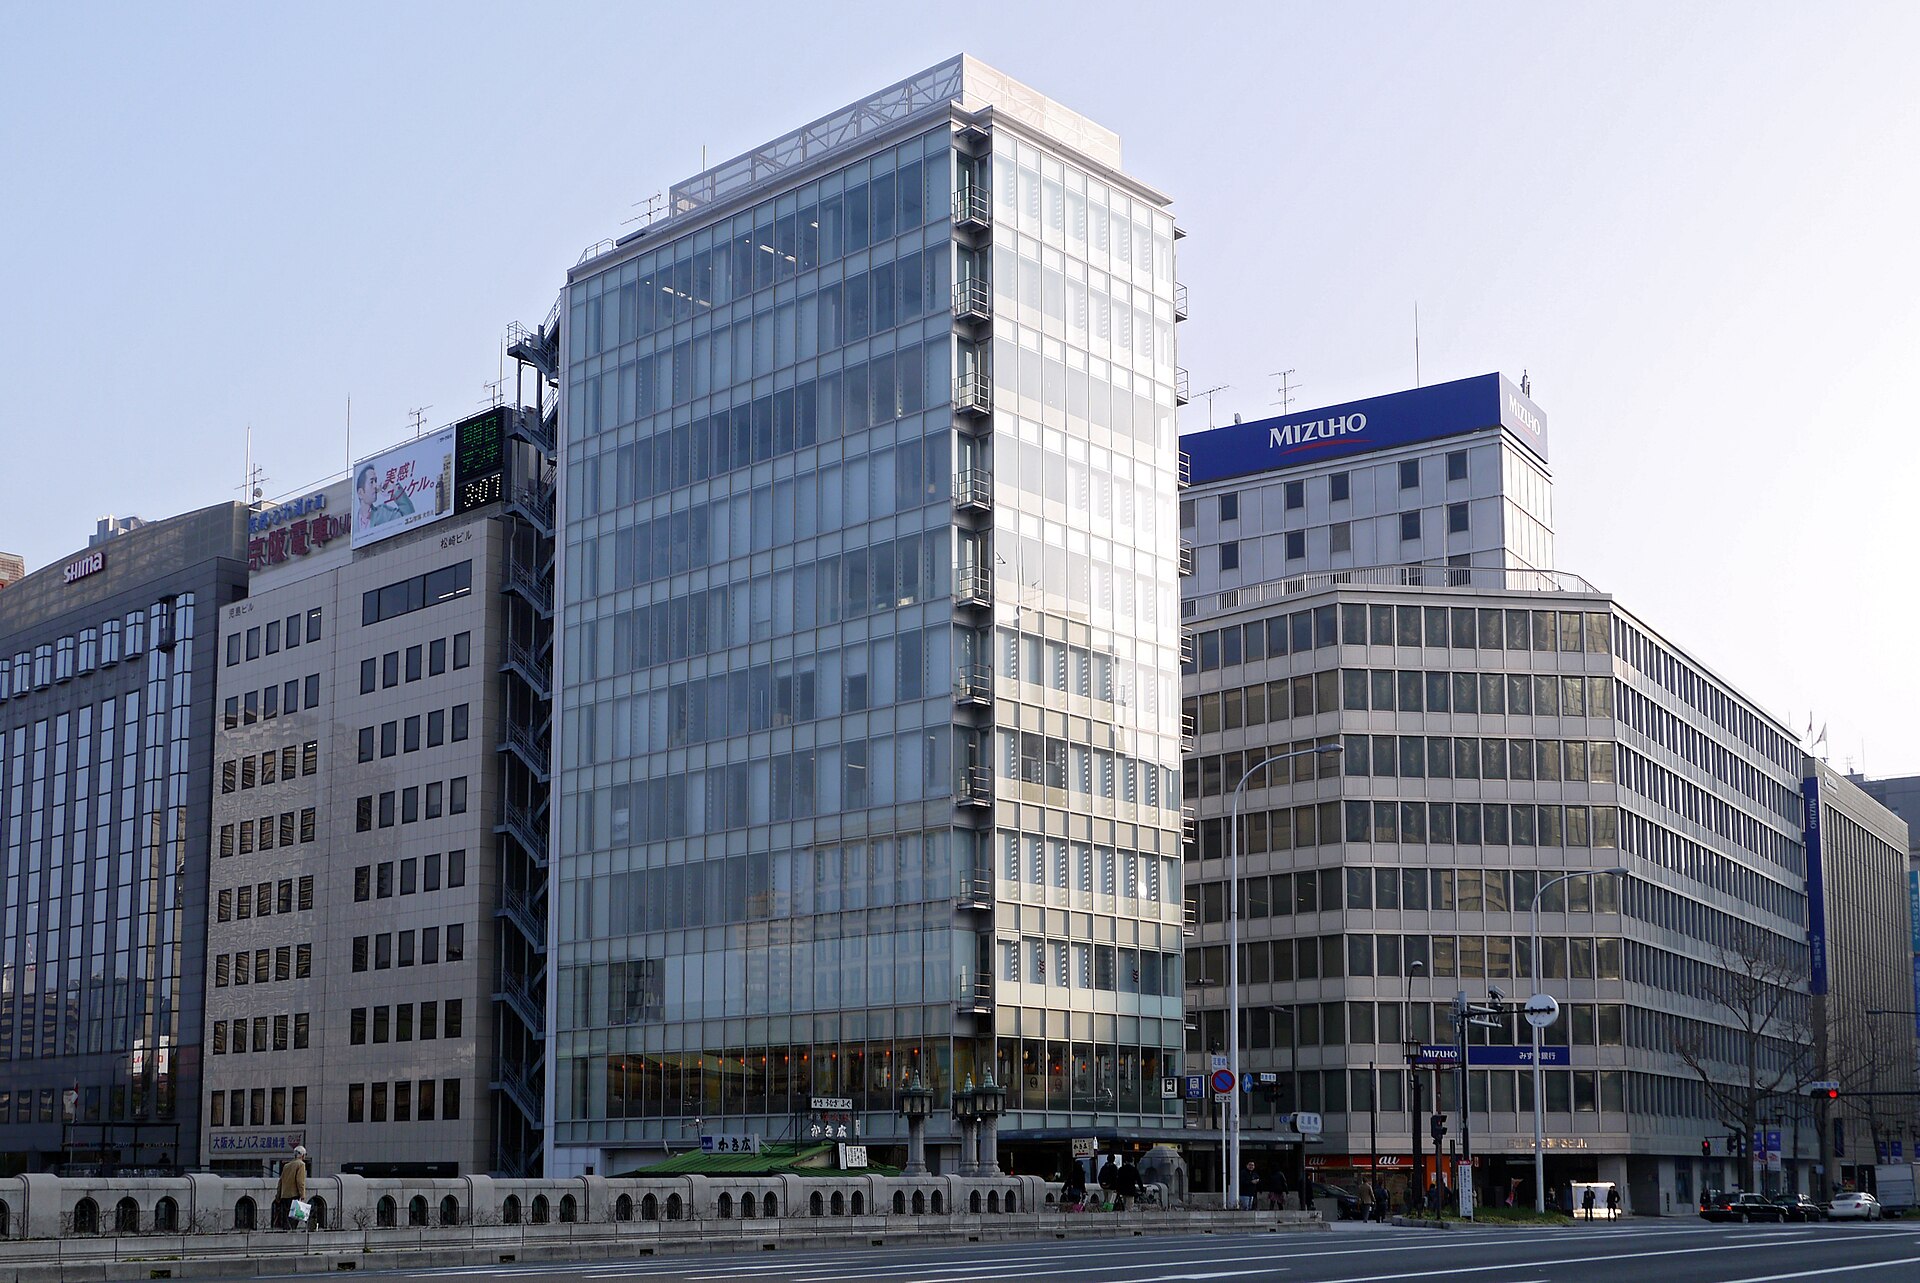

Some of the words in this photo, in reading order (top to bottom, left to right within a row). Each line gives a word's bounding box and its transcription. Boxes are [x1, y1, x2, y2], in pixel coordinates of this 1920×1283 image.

[1509, 393, 1541, 436] MIZUHO
[1269, 413, 1367, 449] MIZUHO
[464, 474, 500, 507] 3:07
[441, 530, 472, 549] 松崎ビル
[1809, 798, 1817, 829] MIZUHO
[1422, 1049, 1458, 1059] MIZUHO
[1518, 1052, 1556, 1060] みず銀行
[810, 1124, 848, 1138] かき広
[213, 1136, 258, 1149] 大阪水上バス
[718, 1136, 752, 1151] かき広
[1308, 1156, 1327, 1166] au
[1378, 1155, 1400, 1165] au
